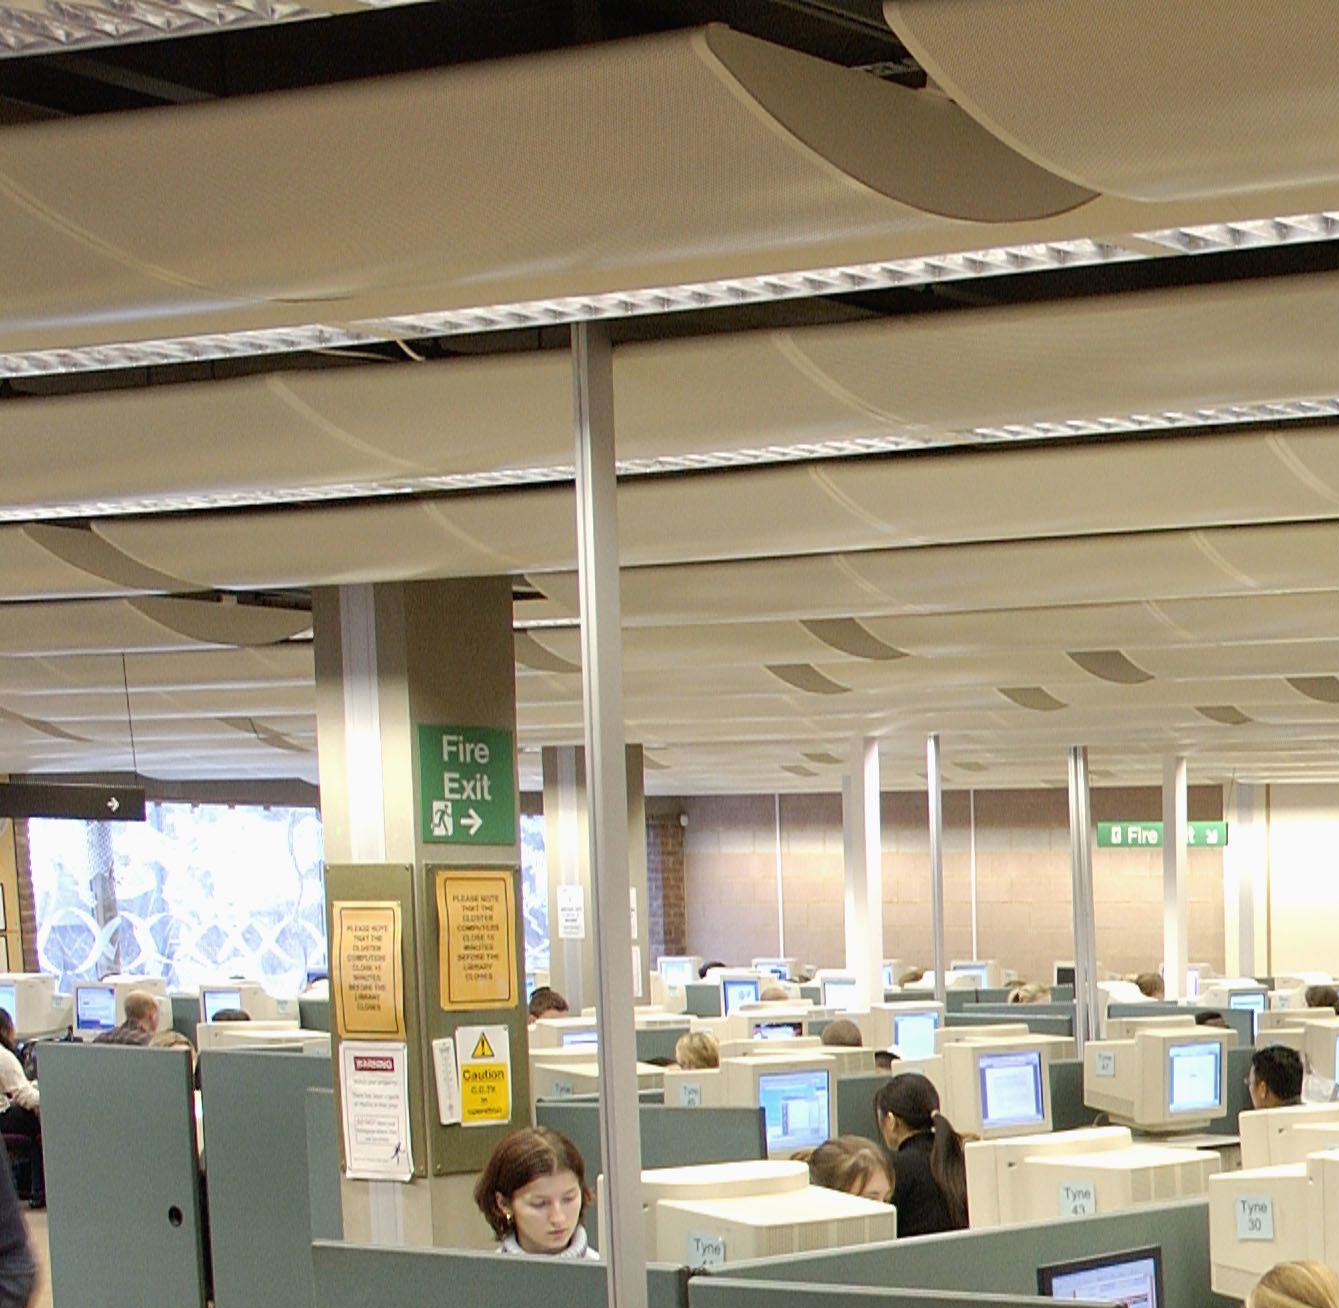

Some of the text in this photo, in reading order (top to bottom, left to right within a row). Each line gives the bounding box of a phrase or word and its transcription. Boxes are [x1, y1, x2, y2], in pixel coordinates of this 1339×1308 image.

[442, 734, 490, 764] Fire
[444, 772, 492, 801] Exit
[1127, 826, 1158, 844] Fire
[462, 1068, 504, 1081] Caution
[1064, 1186, 1091, 1202] Tyne
[1240, 1199, 1268, 1216] Tyne
[1248, 1217, 1262, 1232] 30
[693, 1238, 721, 1257] Tyne
